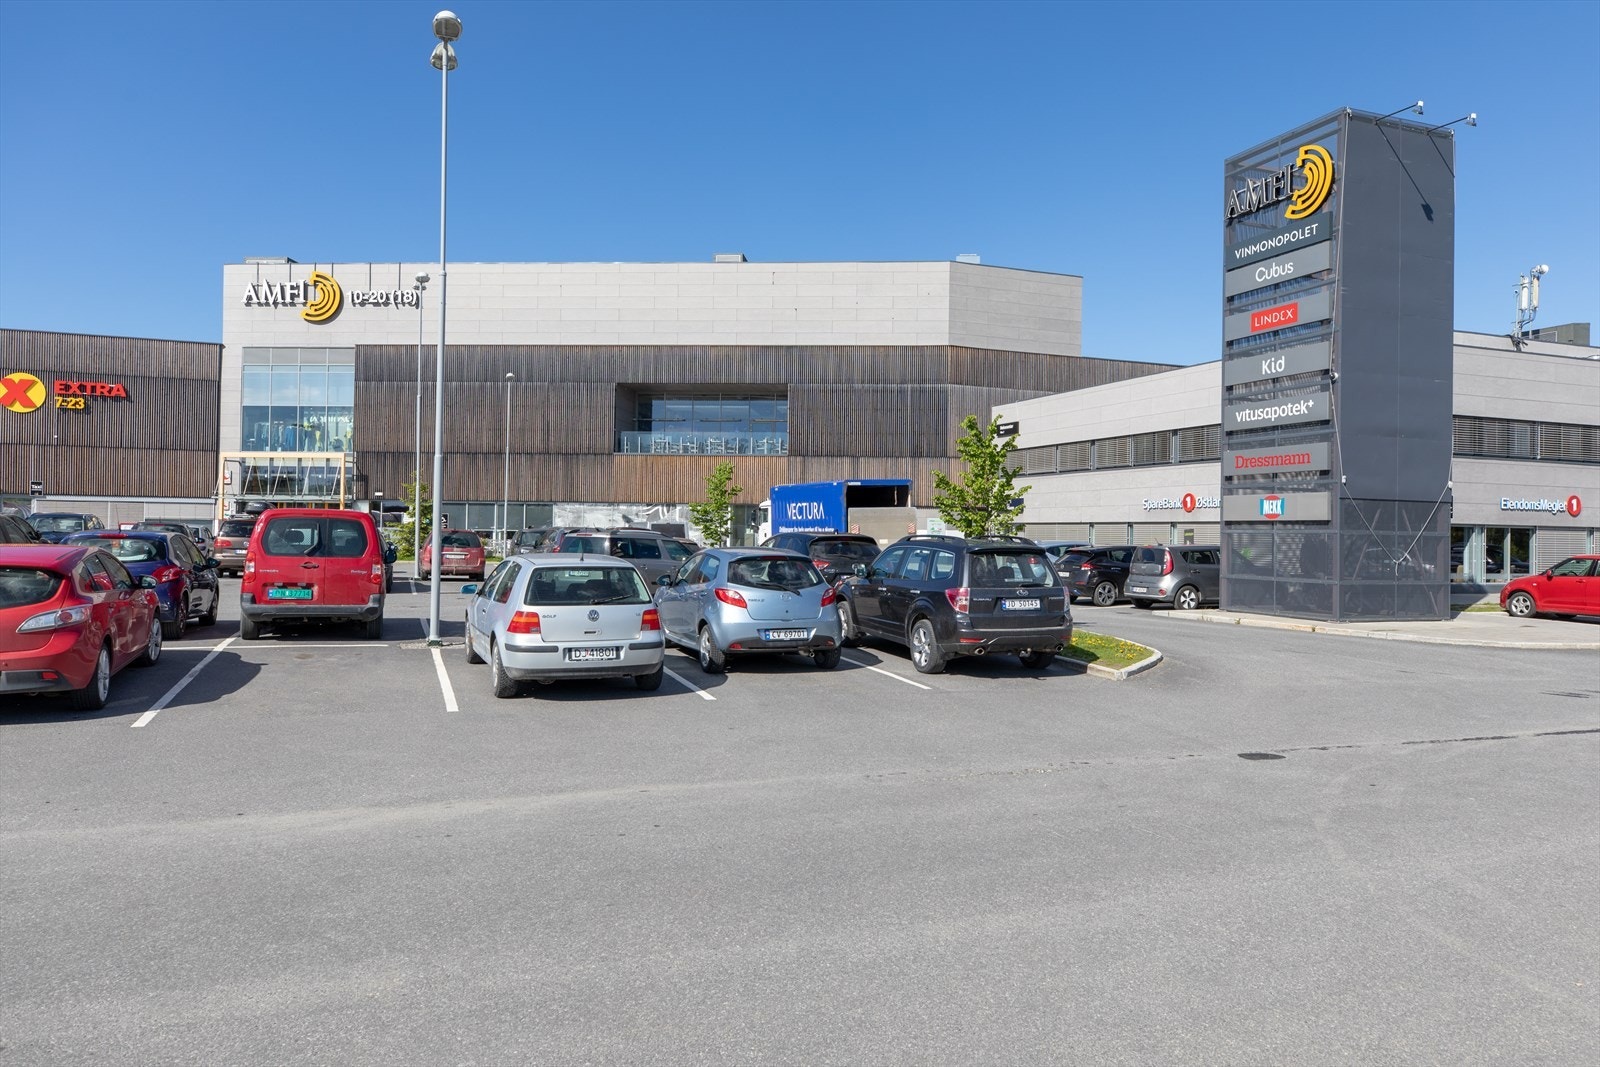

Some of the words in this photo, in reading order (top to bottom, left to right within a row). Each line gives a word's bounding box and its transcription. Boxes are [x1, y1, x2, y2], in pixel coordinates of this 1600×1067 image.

[1224, 163, 1298, 220] AMFI
[1235, 223, 1319, 259] VINMONOPOLET
[1255, 261, 1294, 282] Cubus
[242, 278, 308, 304] AMFI
[347, 290, 386, 304] 10-20
[390, 290, 418, 306] (18)
[1262, 356, 1285, 375] Kid
[54, 380, 127, 398] EXTRA
[54, 397, 85, 409] 7-23
[1235, 452, 1311, 469] Dressmann
[786, 502, 825, 520] VECTURA
[1142, 497, 1183, 511] SpareBank
[1501, 497, 1568, 515] EiendomsMegler
[574, 648, 587, 658] DJ
[589, 647, 615, 657] 41801
